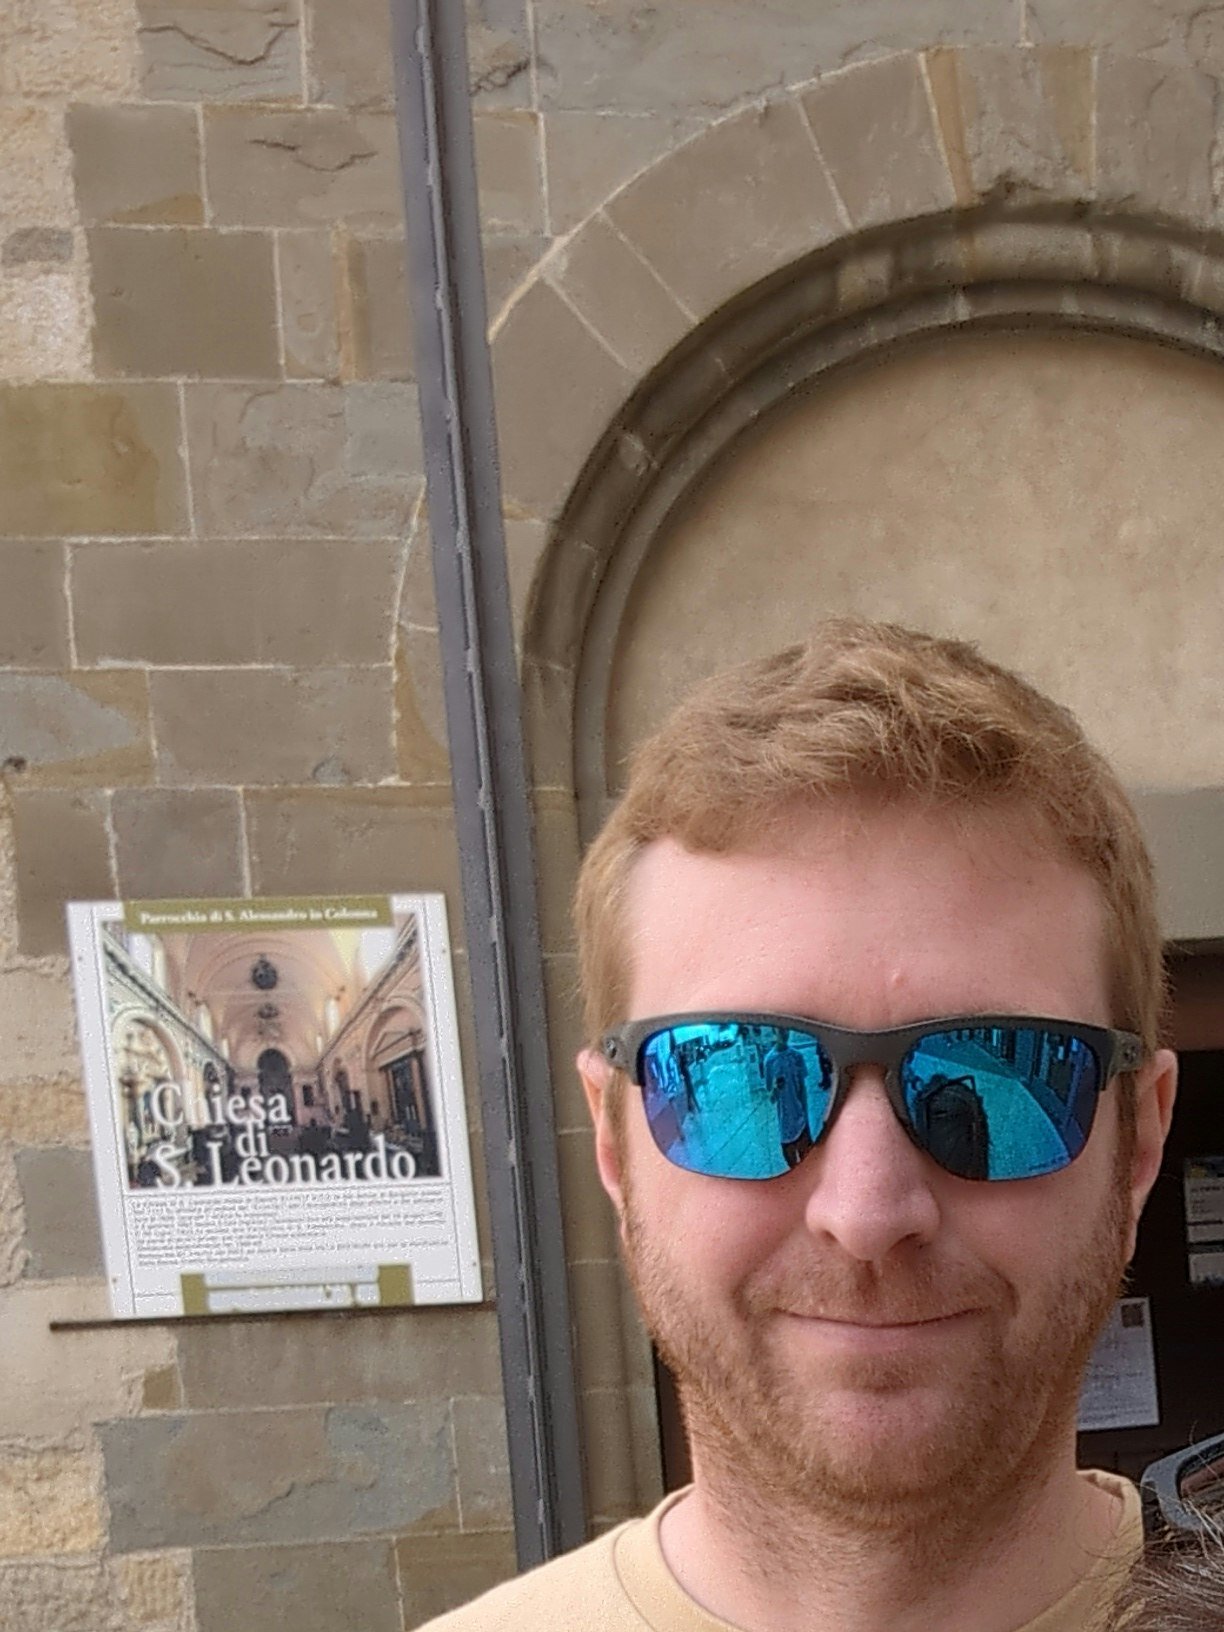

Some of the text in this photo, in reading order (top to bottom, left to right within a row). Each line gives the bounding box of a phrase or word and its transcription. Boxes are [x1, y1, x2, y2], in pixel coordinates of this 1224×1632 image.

[140, 912, 208, 925] Parrocchia
[210, 910, 223, 922] di
[239, 908, 308, 922] Alessandro
[310, 908, 322, 921] in
[324, 906, 378, 920] Colonna
[151, 1081, 291, 1126] Chiesa
[236, 1119, 270, 1158] di
[155, 1133, 416, 1190] S. Leonardo
